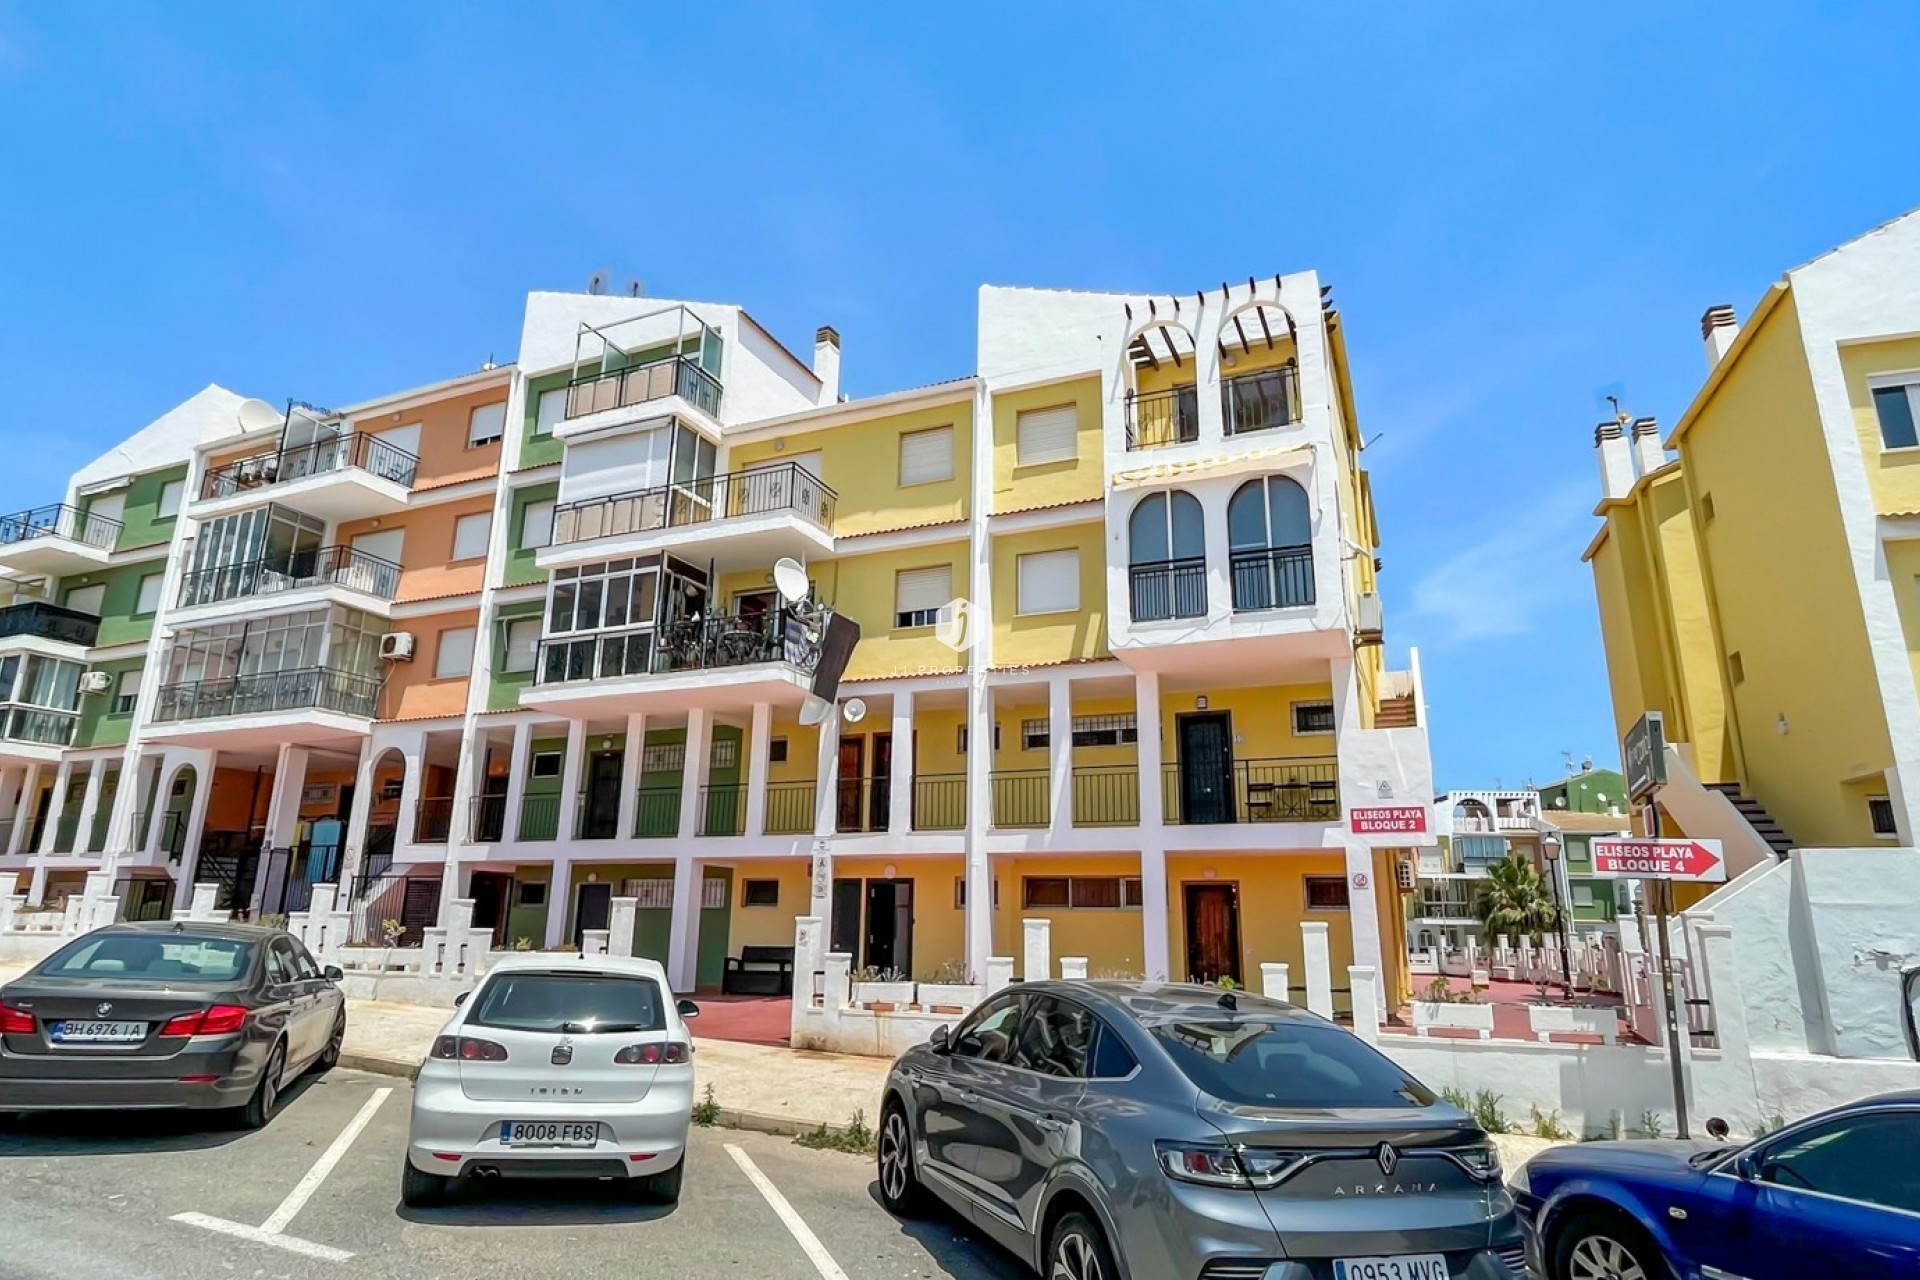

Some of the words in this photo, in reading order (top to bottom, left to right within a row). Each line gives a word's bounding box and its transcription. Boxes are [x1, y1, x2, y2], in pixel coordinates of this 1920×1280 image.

[1352, 810, 1391, 820] ELISEOS
[1393, 809, 1423, 819] PLAYA
[1360, 820, 1407, 830] BLOQUE
[1409, 820, 1417, 830] 2
[1595, 845, 1650, 858] ELISEOS
[1652, 846, 1695, 859] PLAYA
[1608, 859, 1671, 872] BLOQUE
[1674, 860, 1685, 872] 4
[65, 1023, 84, 1035] BH
[86, 1023, 118, 1035] 6976
[513, 1124, 557, 1140] 8008
[562, 1124, 594, 1141] FBS
[1334, 1183, 1437, 1195] ARKANA
[1350, 1262, 1401, 1280] 0953
[1406, 1260, 1444, 1280] MVG
